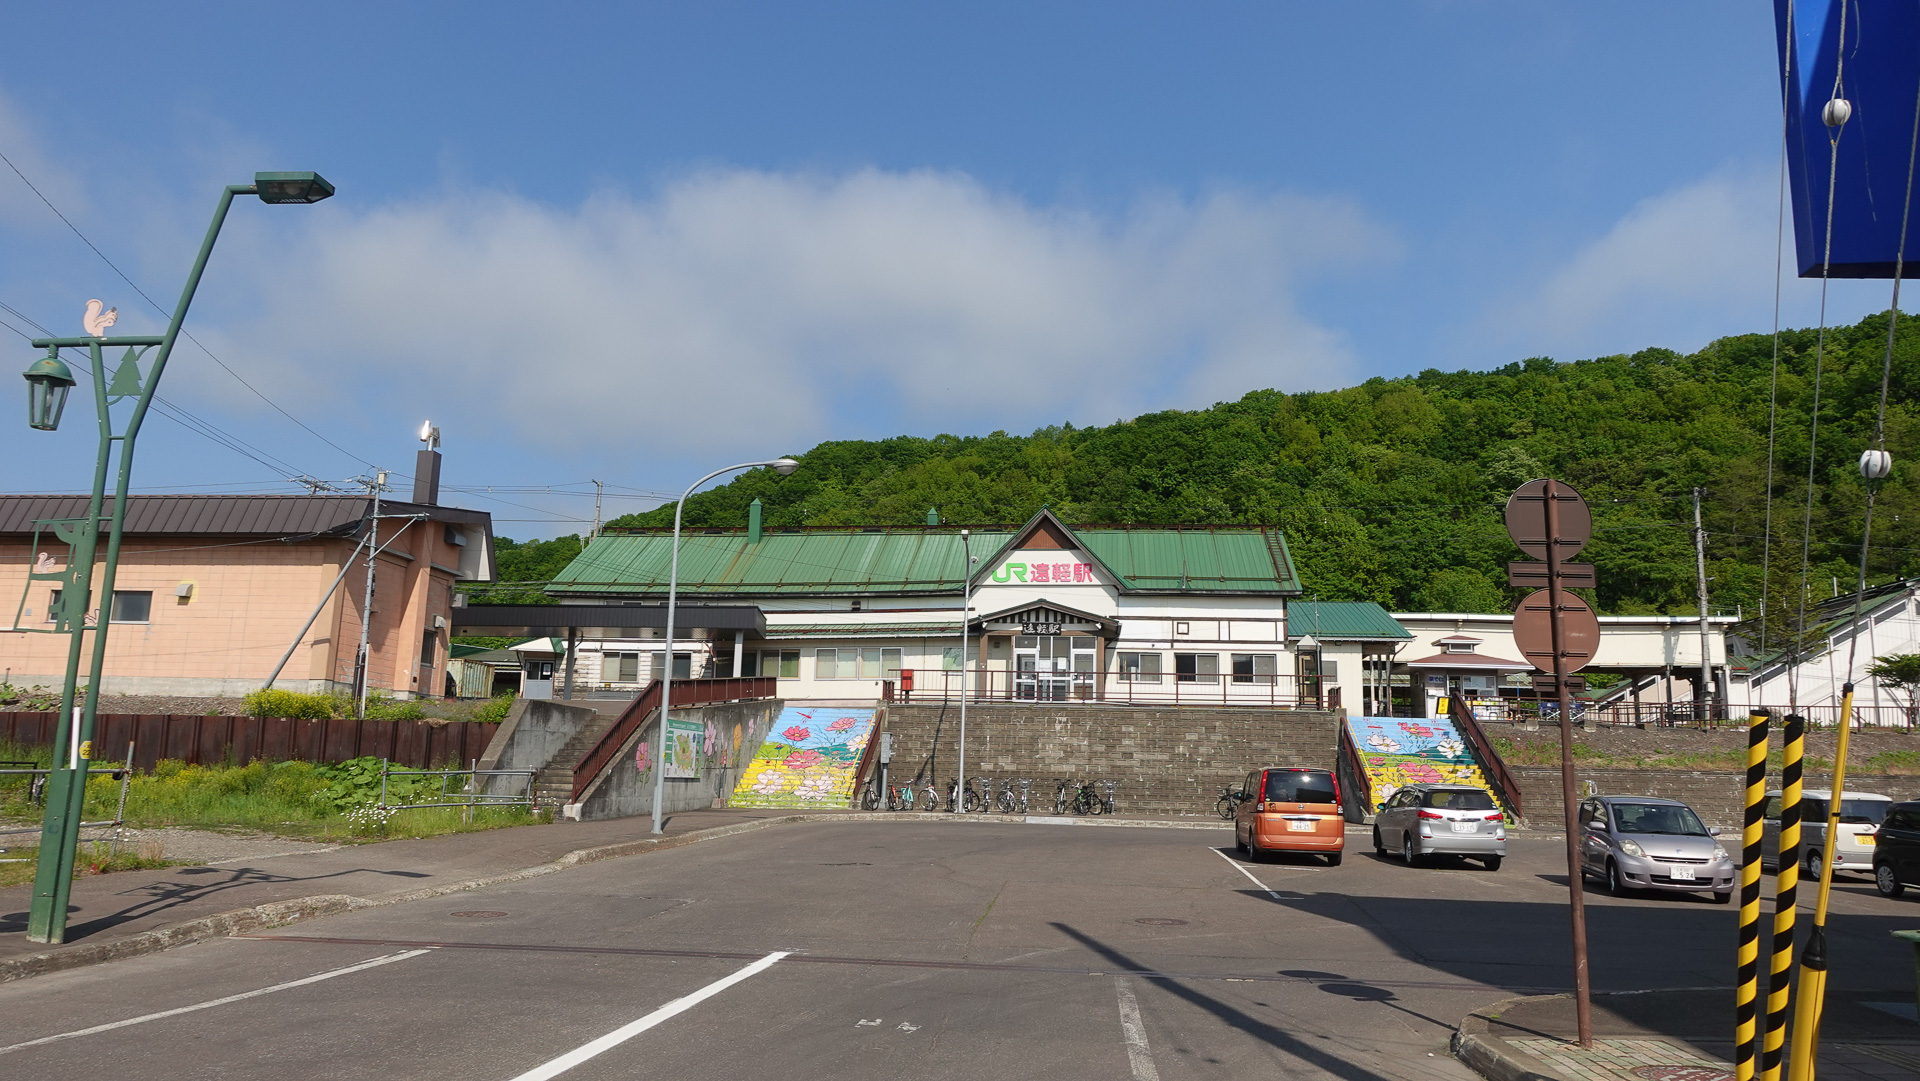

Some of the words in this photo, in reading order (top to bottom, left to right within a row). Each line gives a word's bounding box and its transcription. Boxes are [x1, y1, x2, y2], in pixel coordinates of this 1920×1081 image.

[992, 563, 1028, 583] JR
[1030, 563, 1093, 583] 遠軽駅
